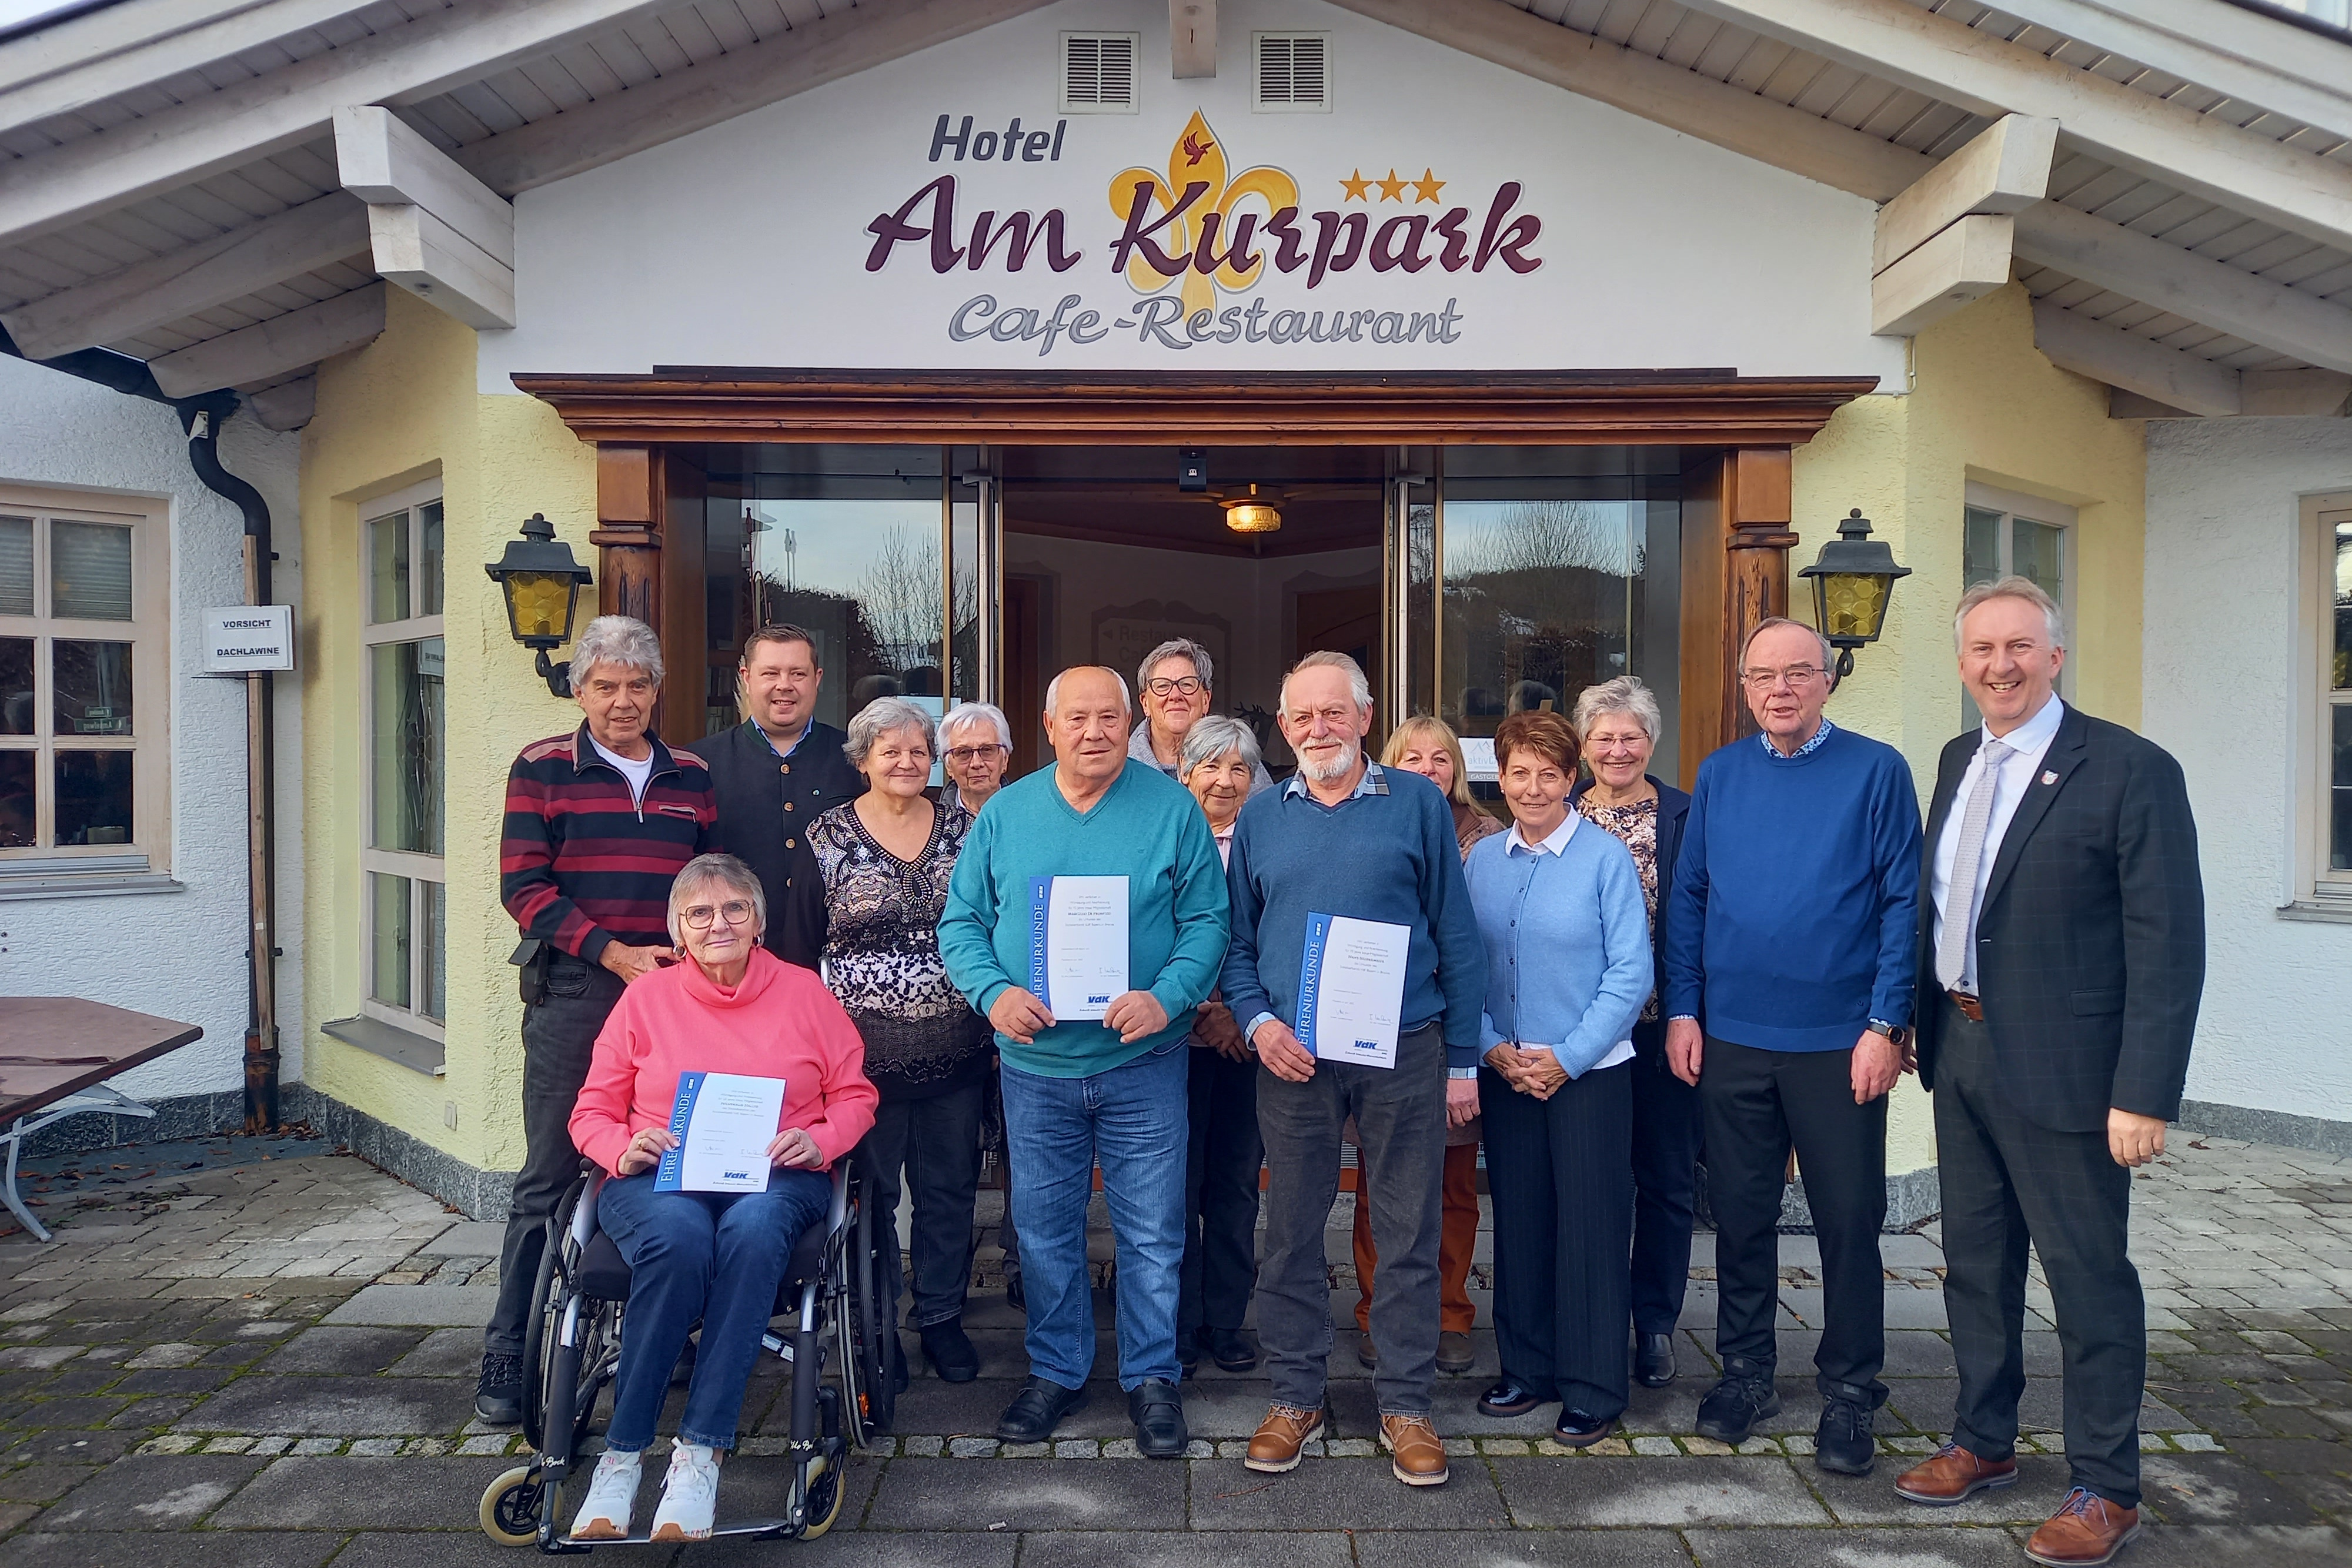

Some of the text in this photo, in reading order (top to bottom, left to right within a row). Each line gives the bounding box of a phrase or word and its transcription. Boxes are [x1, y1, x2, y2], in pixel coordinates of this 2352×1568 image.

[928, 114, 1067, 162] Hotel
[866, 175, 1542, 289] Am Kurpark
[948, 293, 1464, 357] Cafe-Restaurant
[223, 620, 272, 628] VORSICHT
[1119, 624, 1201, 642] Restaut
[217, 647, 280, 656] DACHLAWINE
[1034, 904, 1044, 1001] HRENURKUNDE
[1297, 941, 1319, 1045] EHRENURKUNDE
[1354, 1040, 1378, 1050] VdK
[724, 1171, 749, 1179] VdK
